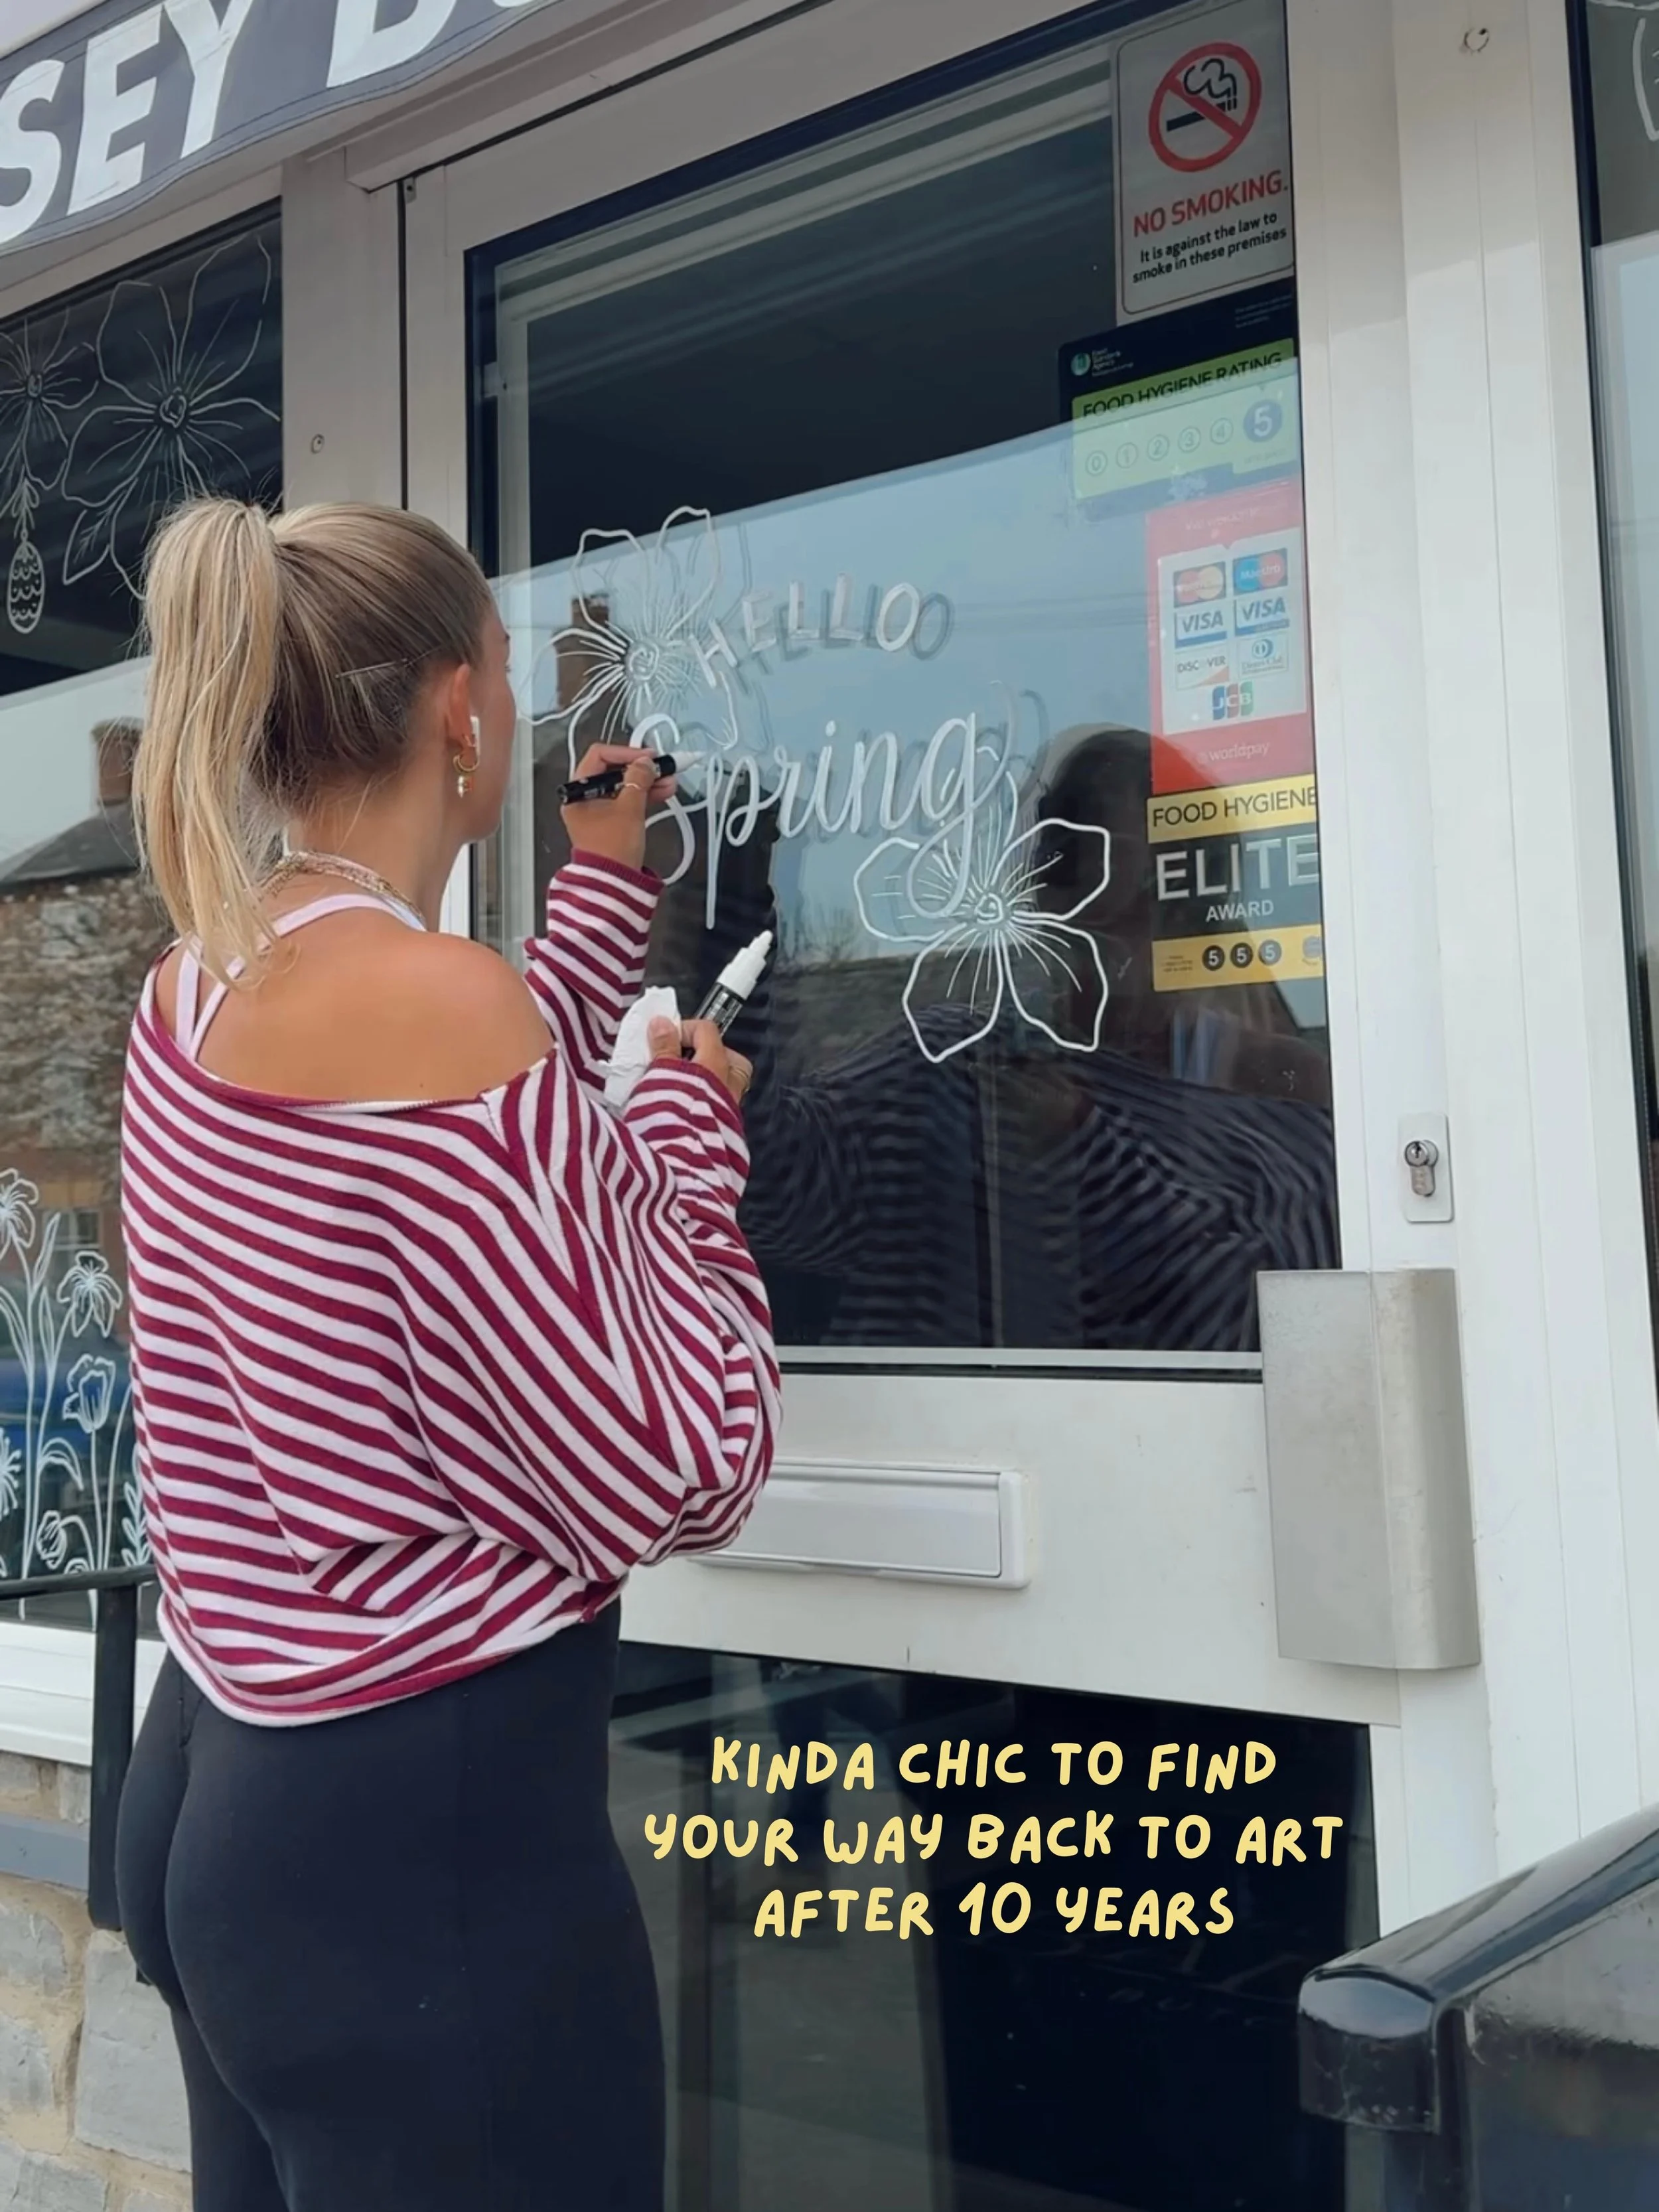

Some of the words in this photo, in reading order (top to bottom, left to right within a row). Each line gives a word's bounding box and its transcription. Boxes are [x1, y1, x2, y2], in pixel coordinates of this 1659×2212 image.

[1134, 207, 1166, 238] NO
[1171, 170, 1288, 226] SMOKING.
[1133, 262, 1173, 283] smoke
[1175, 257, 1187, 270] in
[1190, 247, 1225, 265] these
[1228, 227, 1287, 258] premises
[1141, 250, 1149, 263] It
[1153, 246, 1163, 260] is
[1166, 231, 1211, 258] against
[1214, 224, 1236, 240] the
[1238, 218, 1260, 232] law
[1263, 212, 1277, 225] to
[1083, 394, 1134, 417] FOOD
[1138, 371, 1212, 404] HYGIENE
[1215, 352, 1282, 382] RATING
[1254, 406, 1273, 437] 5
[687, 573, 921, 688] HELLO
[1182, 610, 1224, 632] VISA
[1242, 597, 1286, 621] VISA
[1209, 742, 1271, 761] worldpay
[629, 681, 1015, 929] Spring
[1153, 801, 1217, 827] FOOD
[1224, 786, 1317, 818] HYGIENE
[1156, 833, 1319, 901] ELITE
[1206, 899, 1274, 922] AWARD
[1208, 950, 1219, 966] 5
[1236, 947, 1248, 964] 5
[1265, 943, 1276, 960] 5
